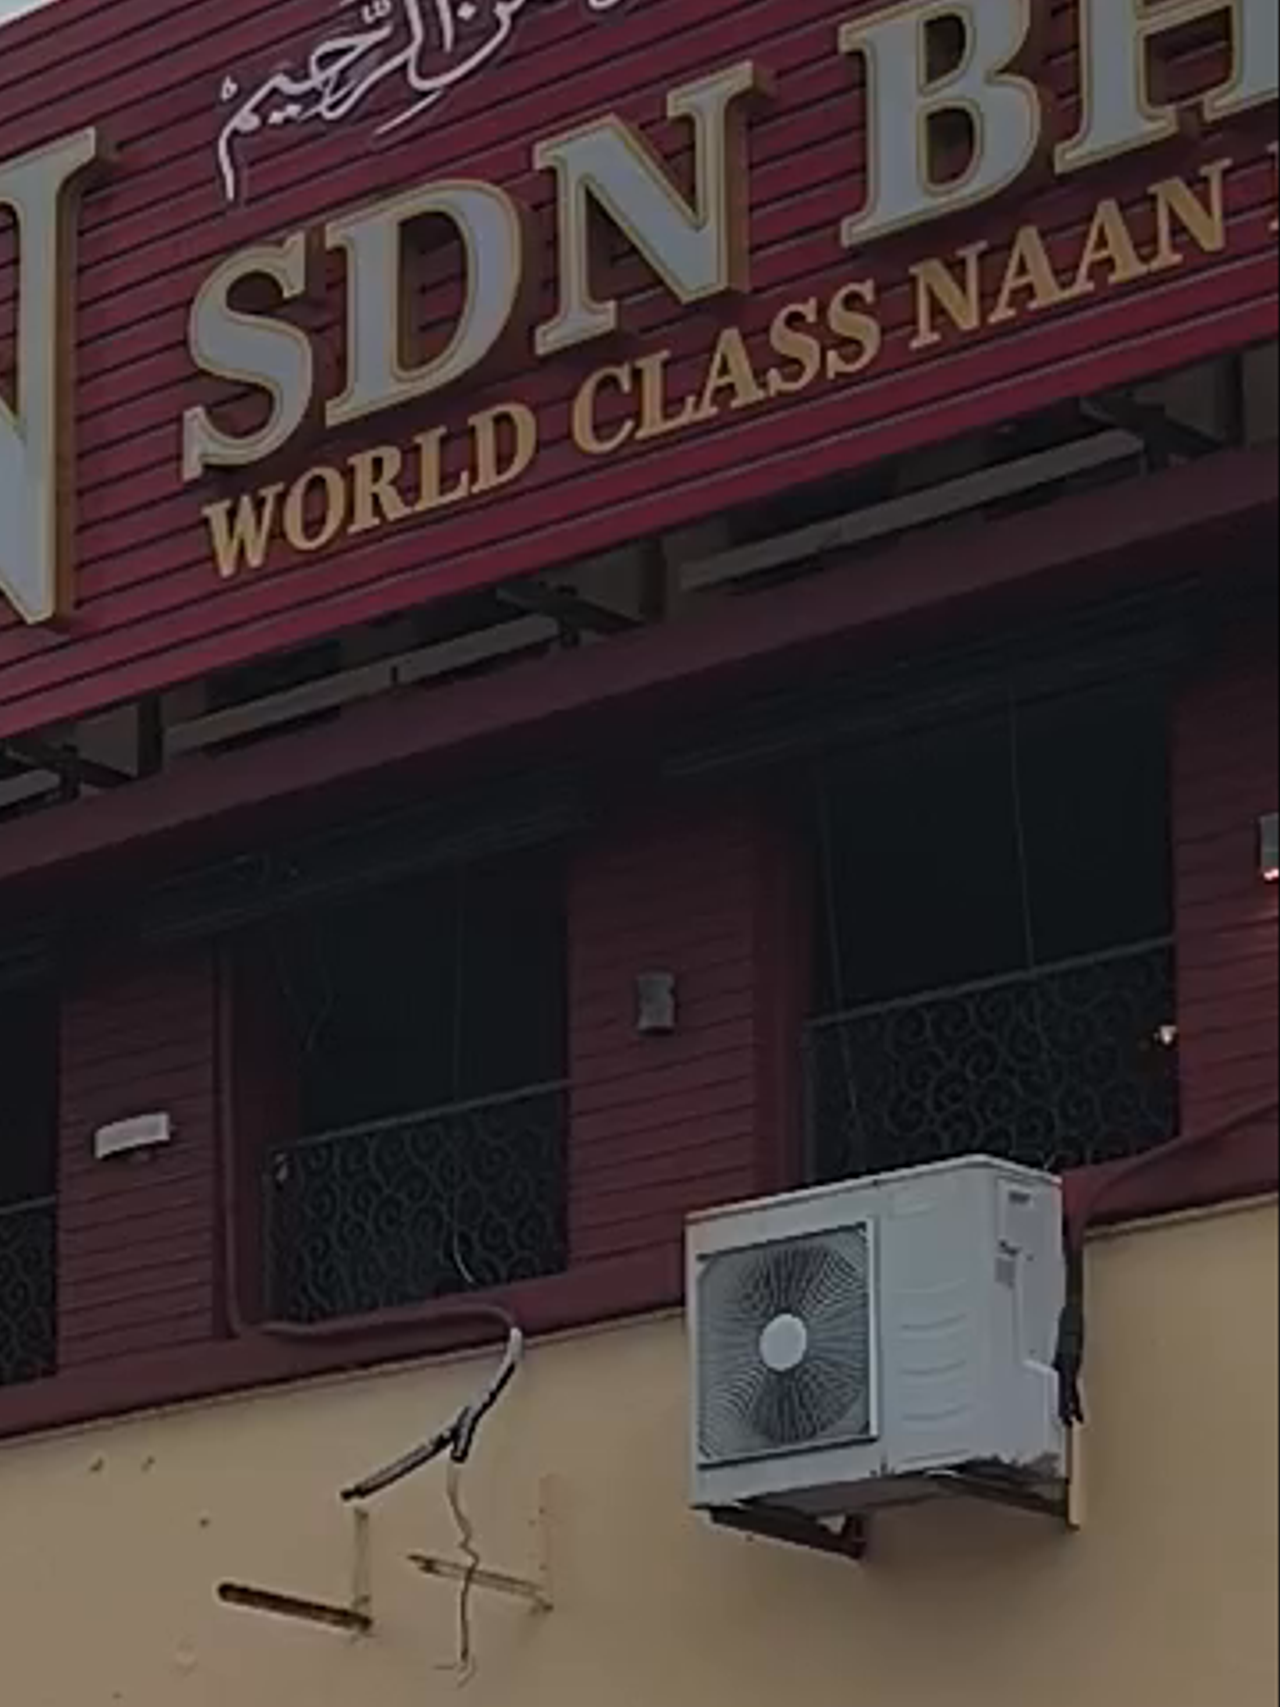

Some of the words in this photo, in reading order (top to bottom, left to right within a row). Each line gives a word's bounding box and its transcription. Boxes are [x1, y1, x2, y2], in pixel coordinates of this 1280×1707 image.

[182, 60, 771, 481] SDN
[201, 402, 537, 579] WORLD
[571, 279, 881, 456] CLASS
[908, 159, 1233, 350] NAAN
